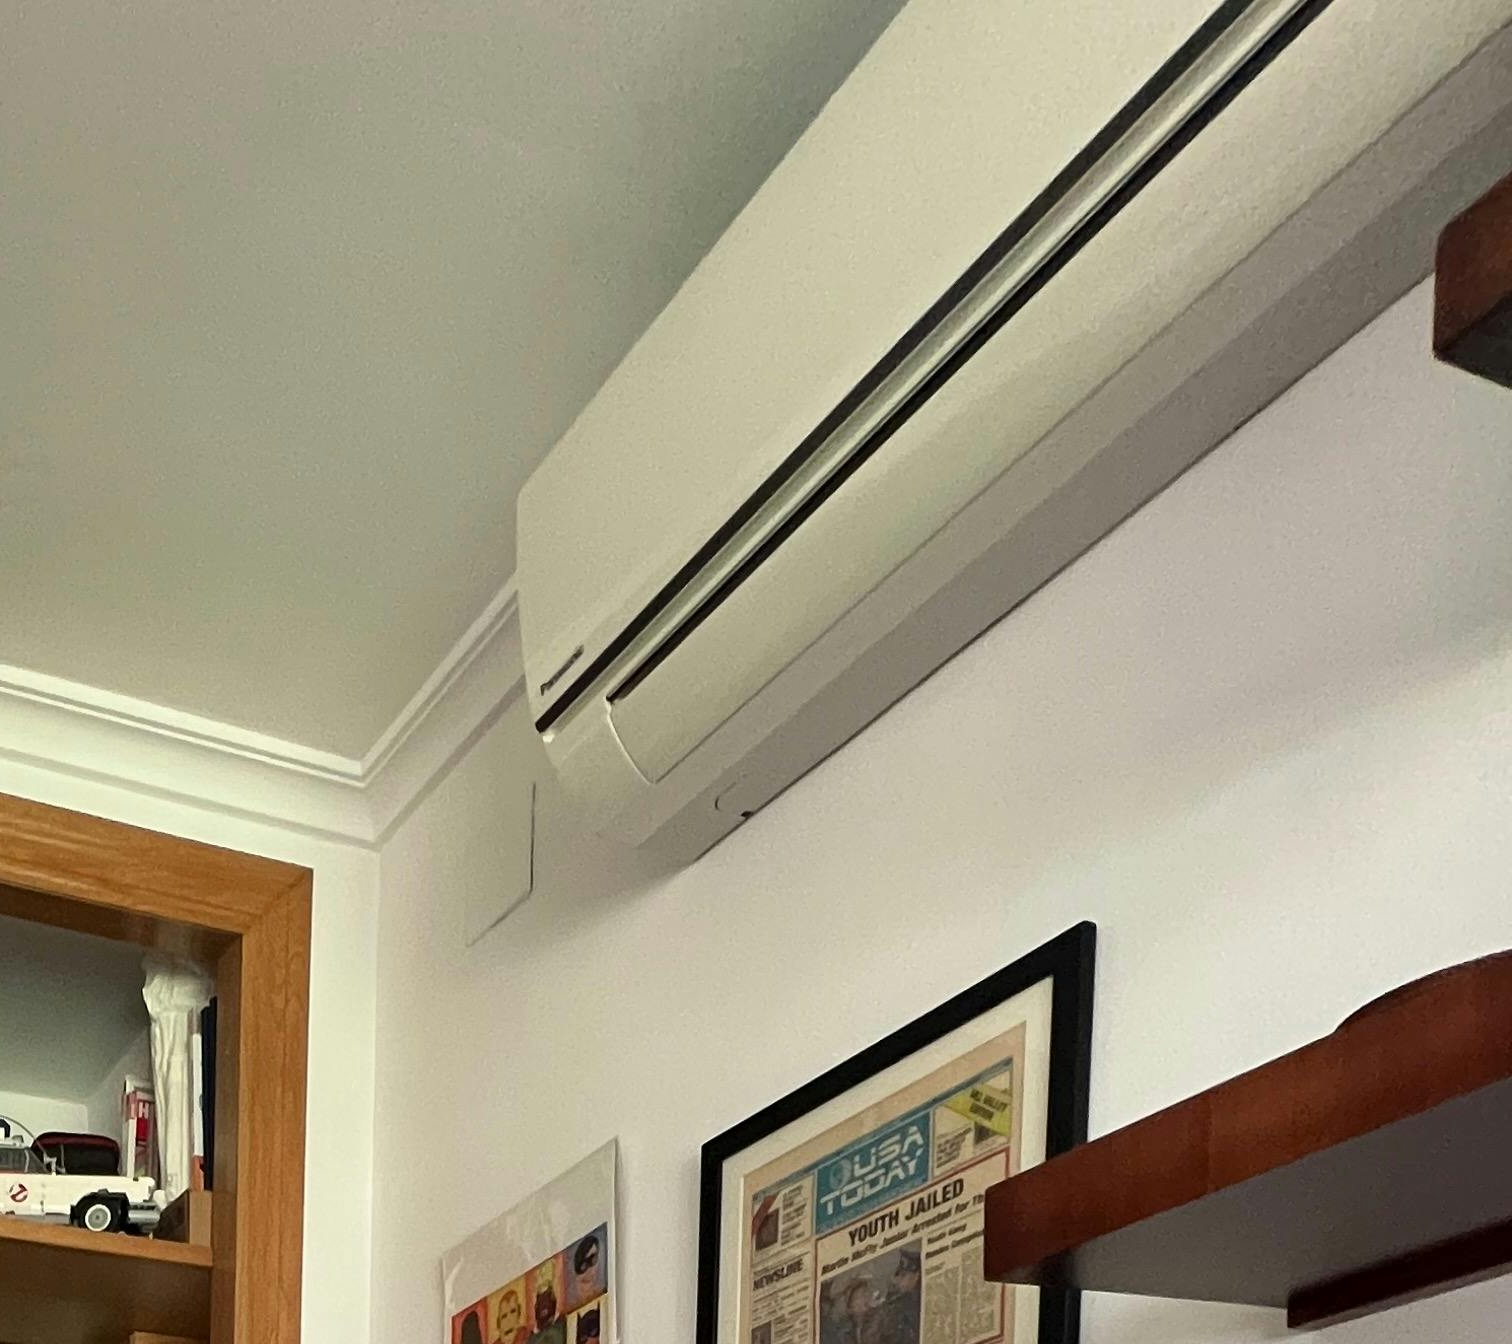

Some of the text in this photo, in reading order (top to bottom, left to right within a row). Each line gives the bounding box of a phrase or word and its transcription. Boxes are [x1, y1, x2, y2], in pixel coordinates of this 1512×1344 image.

[819, 1147, 926, 1216] TODAY
[852, 1125, 924, 1176] USA
[848, 1208, 901, 1247] YOUTH
[904, 1177, 965, 1221] JAILED
